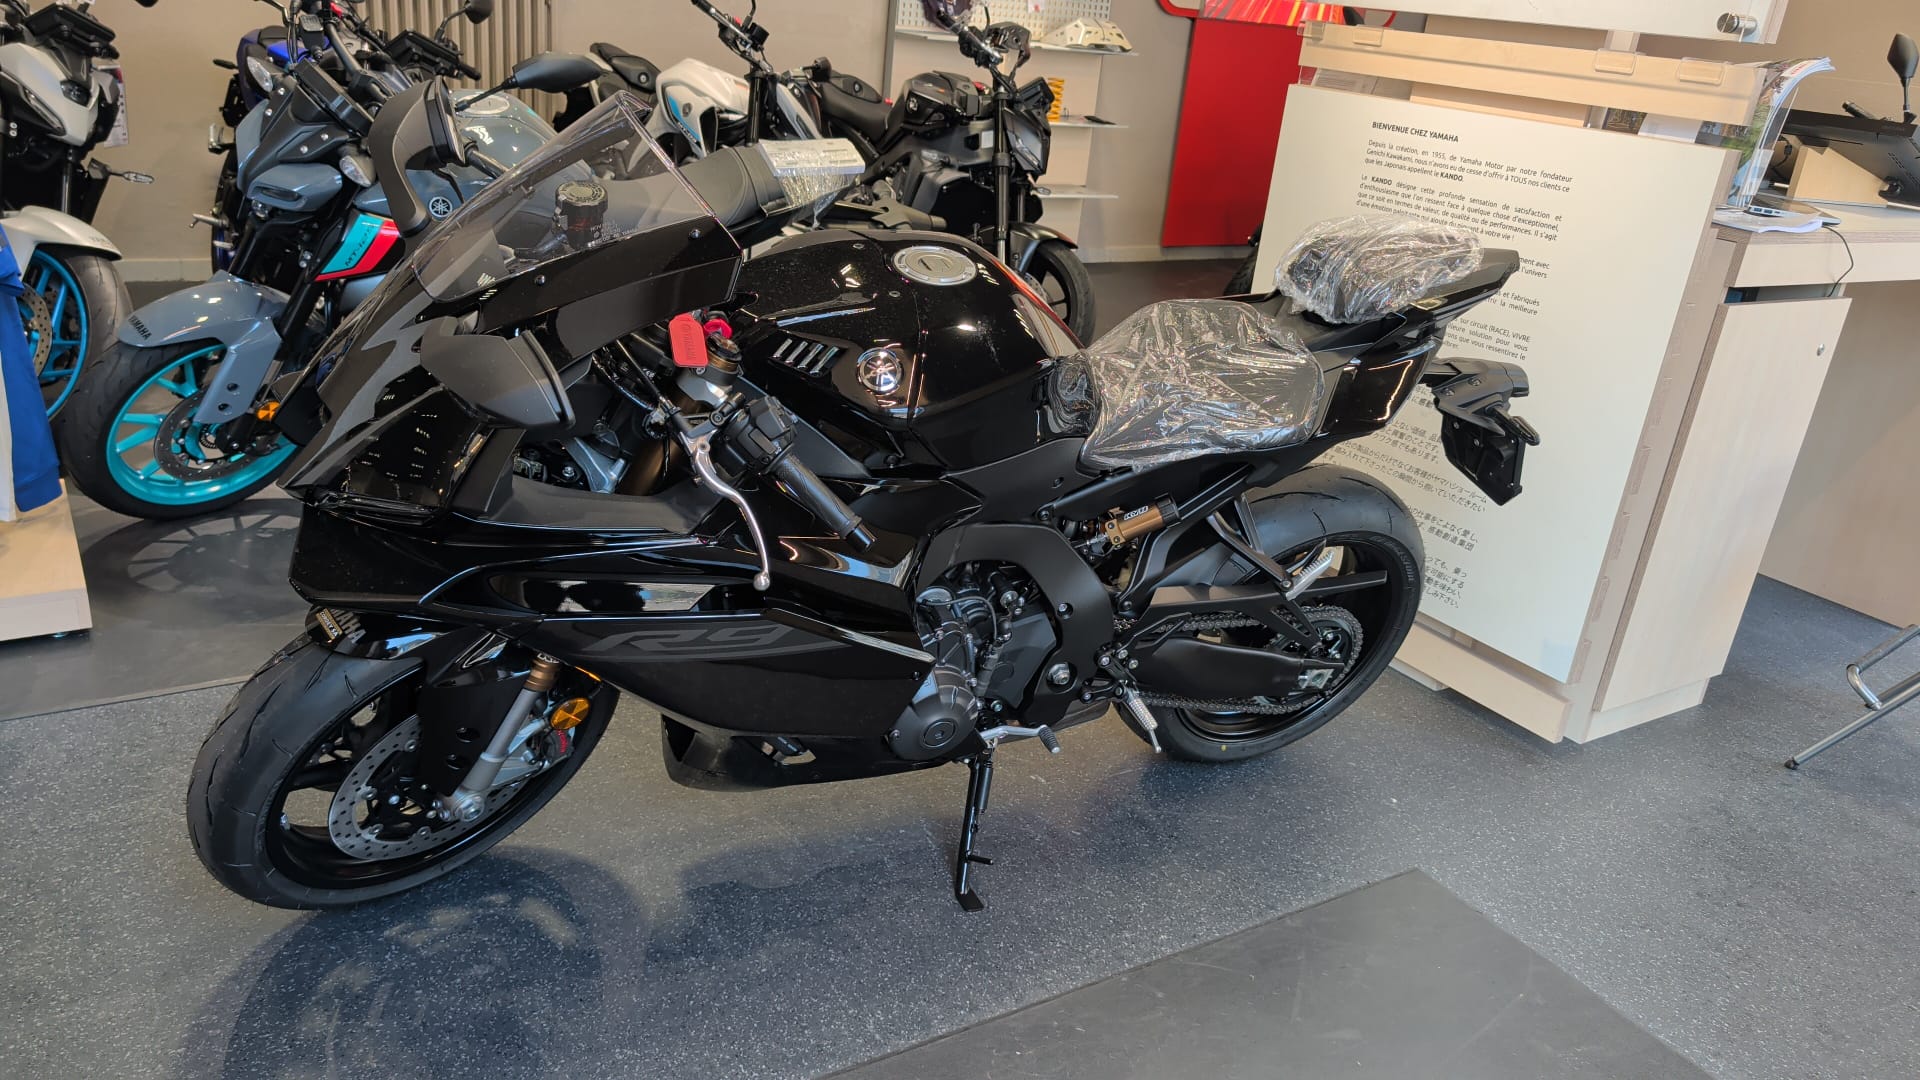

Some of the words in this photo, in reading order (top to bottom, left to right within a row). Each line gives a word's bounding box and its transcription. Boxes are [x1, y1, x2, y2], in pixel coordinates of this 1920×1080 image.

[1372, 121, 1409, 135] BIENVENUE
[1410, 128, 1429, 138] CHEZ
[1429, 130, 1459, 142] YAMAHA
[1366, 148, 1385, 157] Genichi
[1509, 175, 1527, 184] TOUS
[1539, 181, 1560, 190] clients
[1368, 139, 1385, 148] Depuis
[1431, 151, 1446, 160] 1955,
[1459, 156, 1482, 165] Yamaha
[1484, 160, 1503, 169] Motor
[1519, 168, 1537, 176] notre
[1540, 170, 1572, 182] fondateur
[1407, 166, 1433, 175] appellent
[1371, 176, 1392, 185] KANDO
[1438, 191, 1465, 201] profonde
[1469, 198, 1497, 207] sensation
[1514, 206, 1550, 218] satisfaction
[1424, 198, 1444, 206] ressent
[1446, 201, 1459, 209] face
[1466, 207, 1490, 216] quelque
[1492, 211, 1509, 220] chose
[1449, 212, 1470, 221] qualité
[1484, 229, 1500, 237] votre
[1518, 257, 1535, 265] ment
[1535, 261, 1550, 269] avec
[1508, 303, 1538, 315] meilleure
[1468, 329, 1492, 341] solution
[1495, 337, 1510, 346] pour
[1513, 343, 1528, 351] vous
[1469, 320, 1488, 330] circuit
[1511, 331, 1530, 342] VIVRE
[1470, 339, 1484, 348] vous
[1485, 344, 1519, 358] ressentirez
